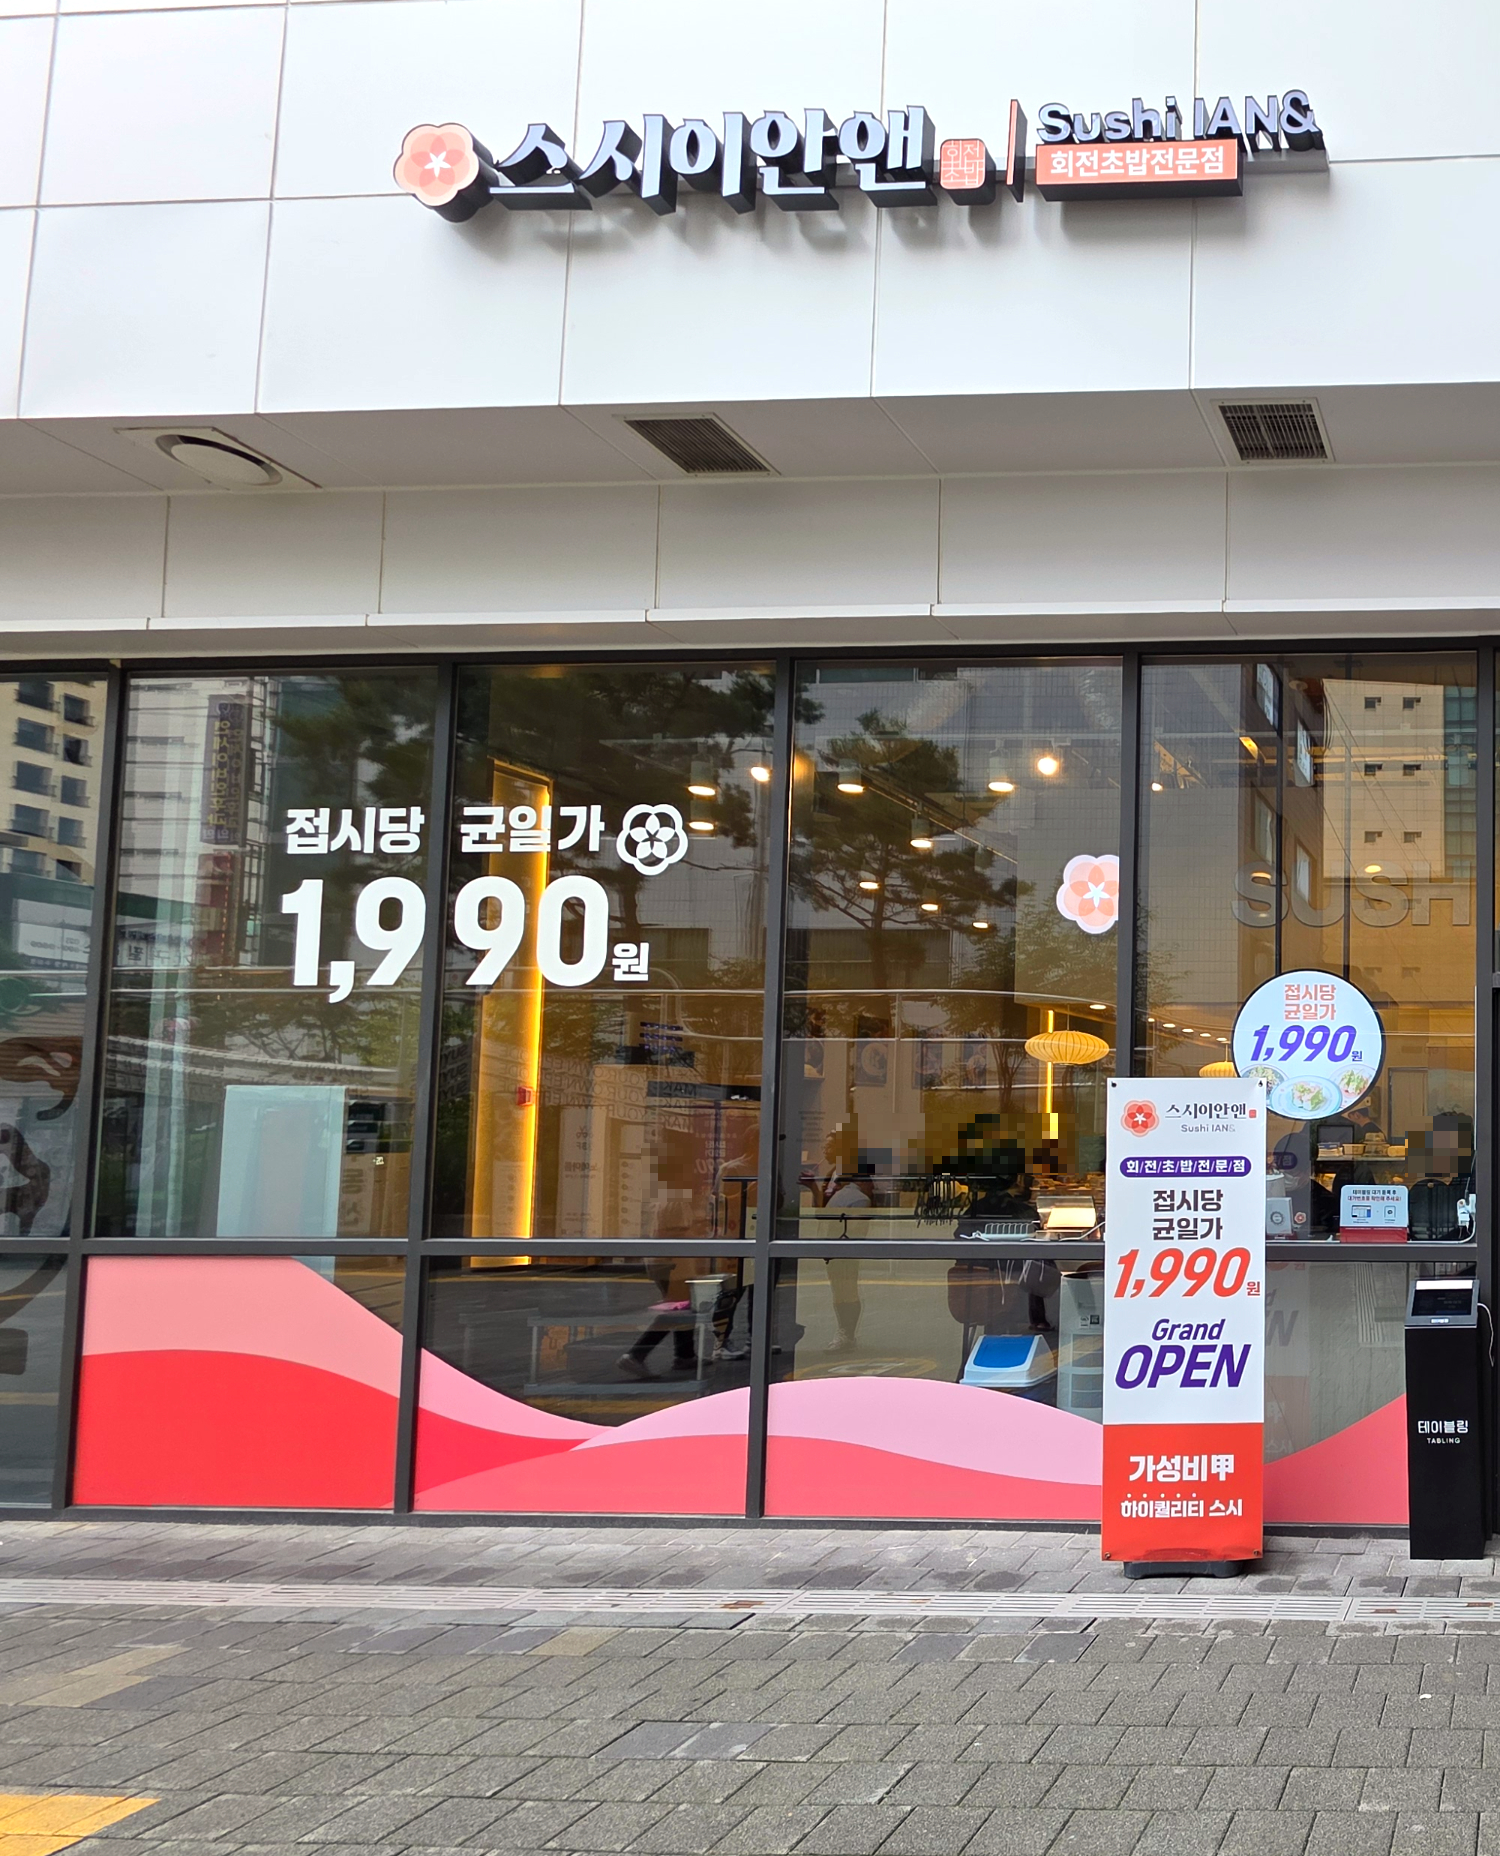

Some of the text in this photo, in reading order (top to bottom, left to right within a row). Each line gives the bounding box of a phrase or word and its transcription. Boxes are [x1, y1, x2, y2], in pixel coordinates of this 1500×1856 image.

[1037, 89, 1320, 143] Sushi IAN&
[488, 104, 928, 200] 스시이안앤
[1050, 145, 1224, 178] 회전초밥전문점
[284, 804, 606, 855] 접시당 균일가
[1283, 983, 1337, 1002] 접시당
[1283, 1002, 1337, 1022] 균일가
[1165, 1102, 1247, 1119] 스시이안앤
[1180, 1123, 1209, 1133] Sushi
[1152, 1189, 1224, 1213] 접시당
[1152, 1217, 1224, 1241] 균일가
[1151, 1318, 1226, 1341] Grand
[1114, 1343, 1252, 1390] OPEN
[1417, 1419, 1469, 1435] 테이블링
[1427, 1437, 1461, 1445] TABLING
[1128, 1454, 1236, 1483] 가성비甲
[1120, 1499, 1243, 1519] 하이퀄리티 스시
